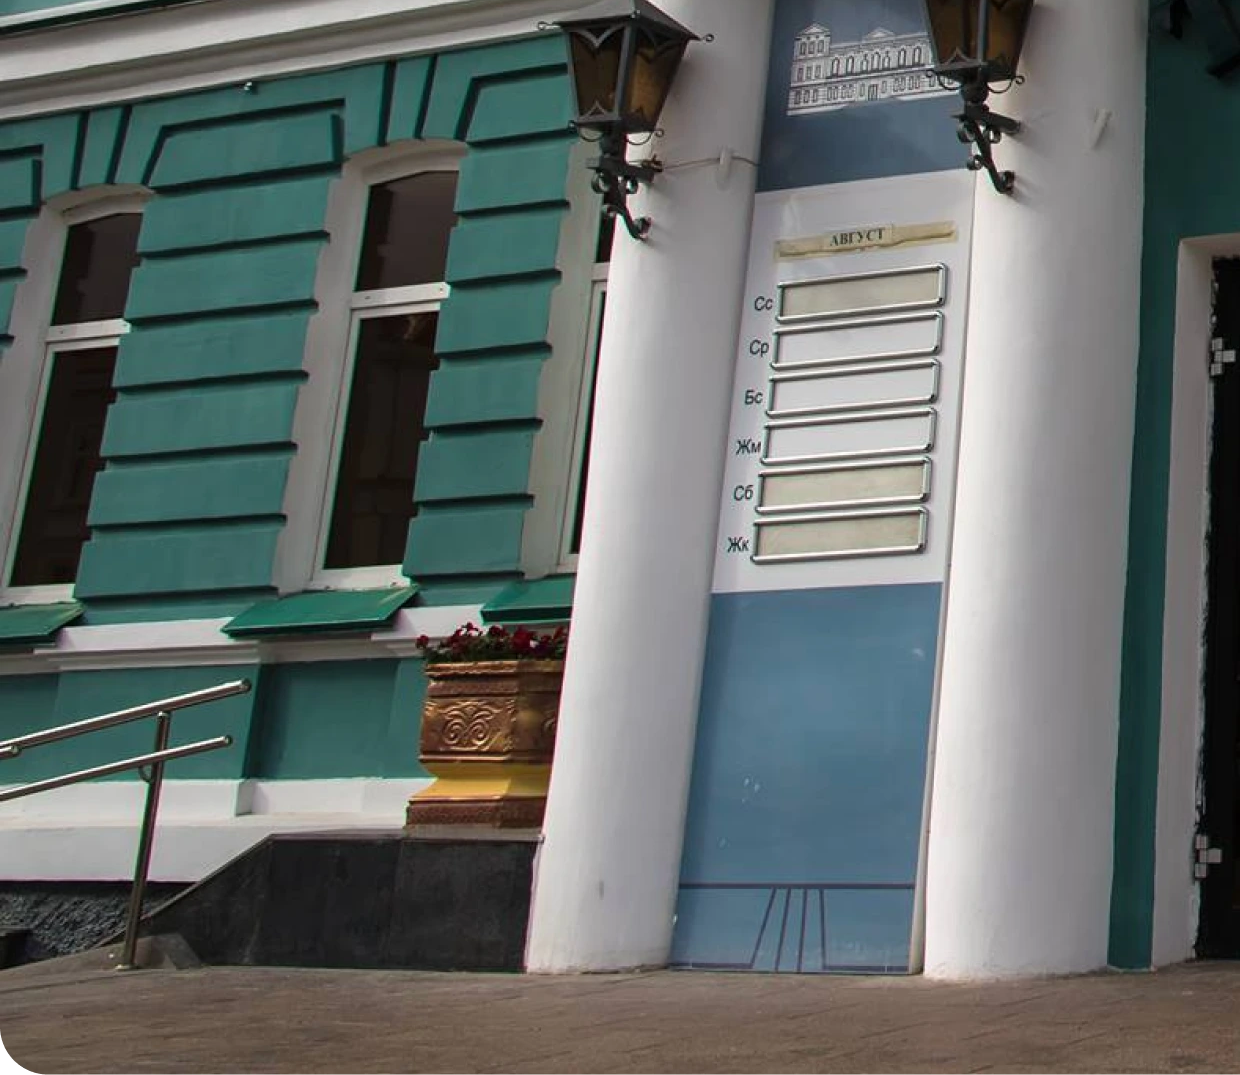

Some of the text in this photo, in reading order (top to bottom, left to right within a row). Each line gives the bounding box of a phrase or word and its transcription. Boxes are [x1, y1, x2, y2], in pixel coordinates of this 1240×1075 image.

[830, 228, 884, 246] АВГУСТ
[754, 296, 773, 312] Сс
[749, 340, 769, 357] Ср
[744, 390, 764, 405] Бс
[735, 438, 761, 455] Жм
[733, 484, 754, 502] Сб
[727, 537, 750, 553] Жк
